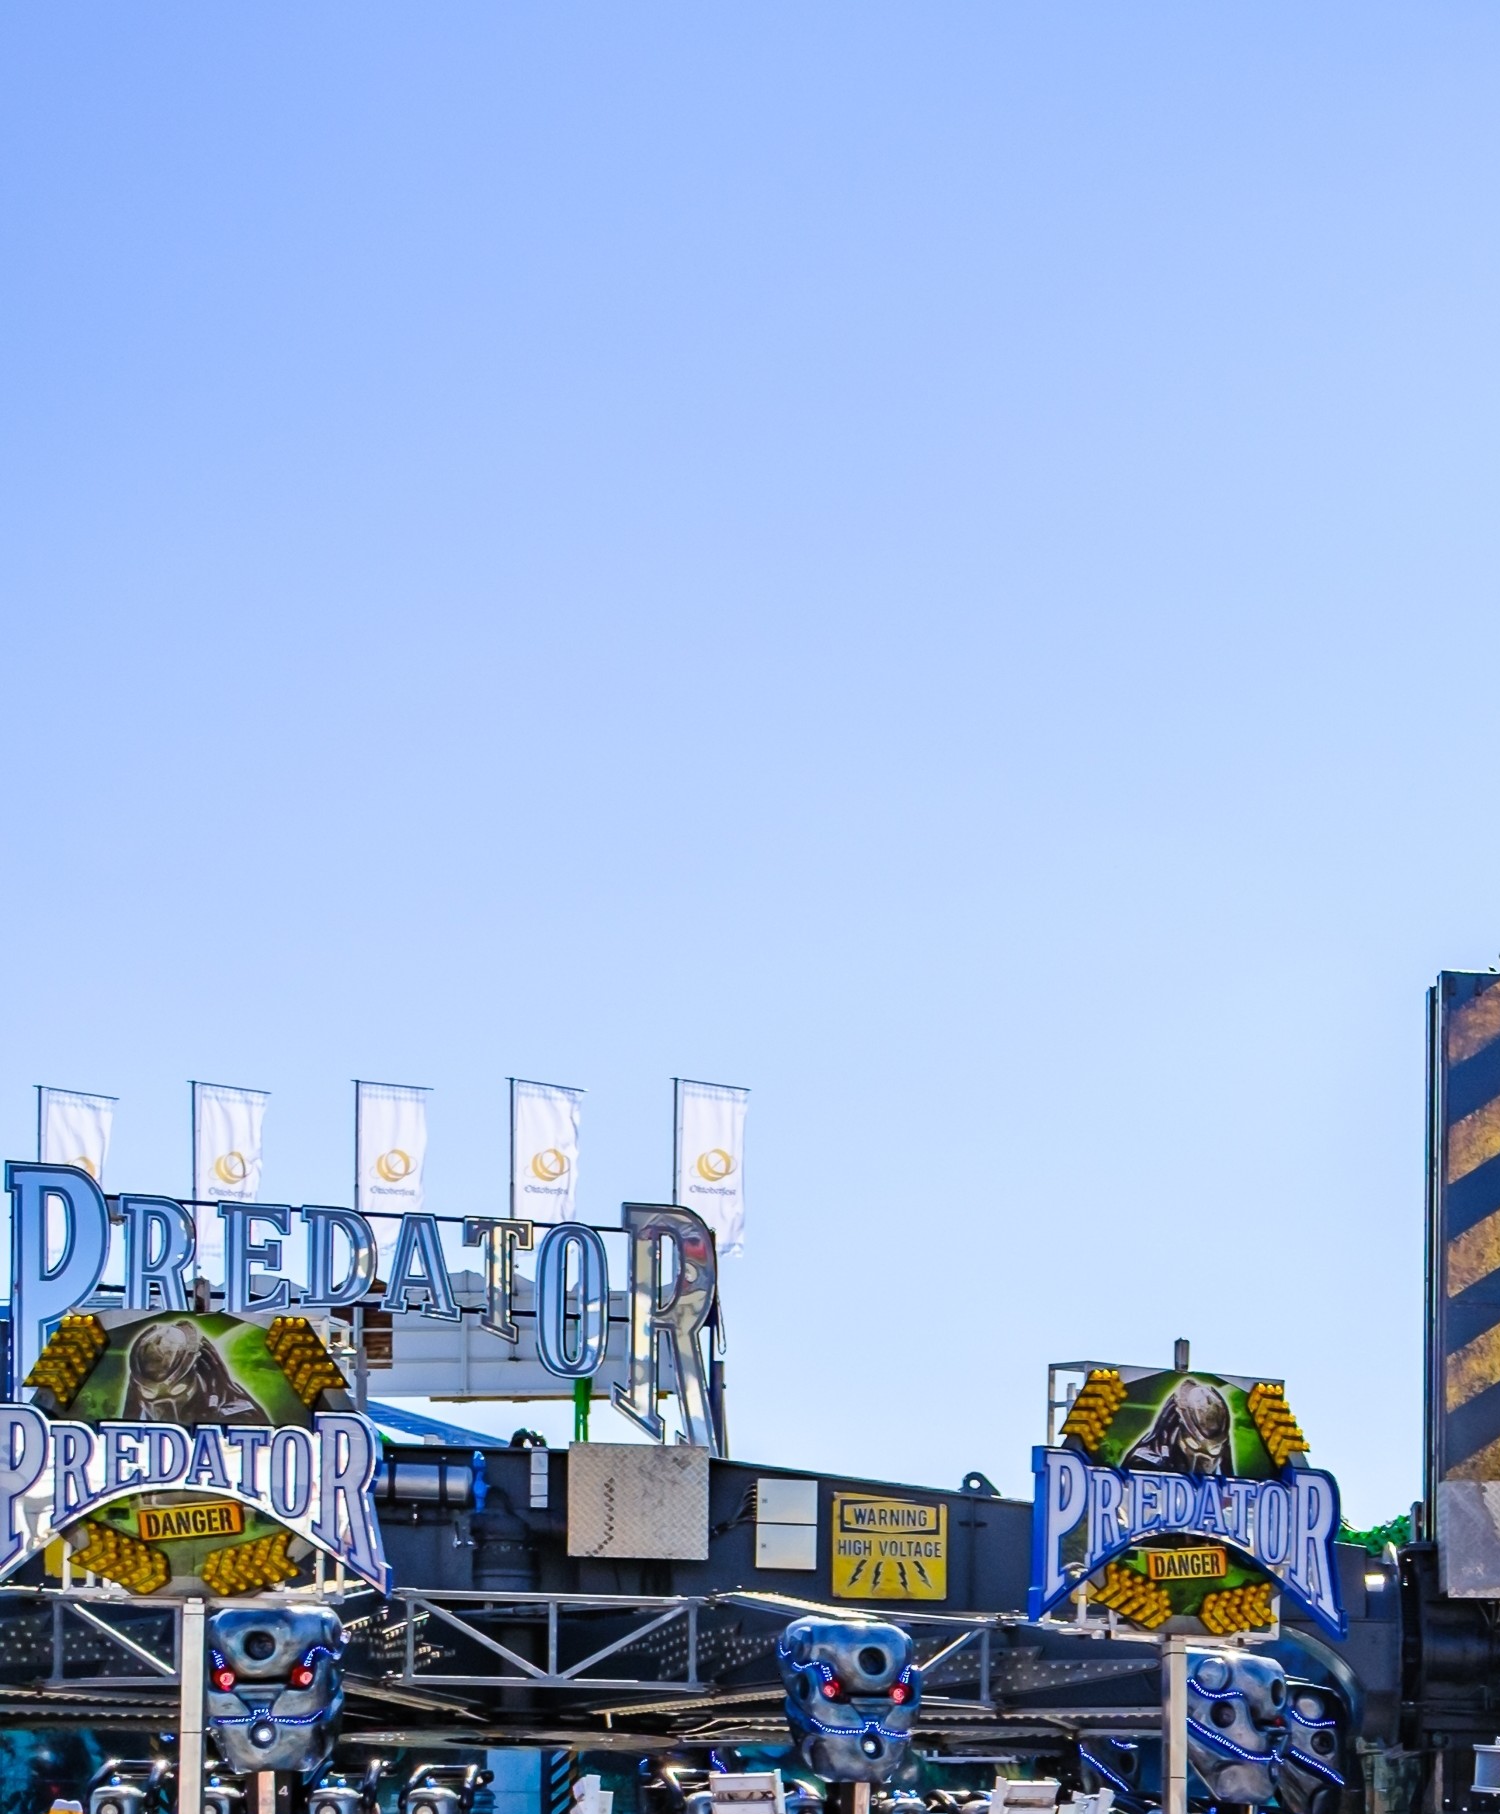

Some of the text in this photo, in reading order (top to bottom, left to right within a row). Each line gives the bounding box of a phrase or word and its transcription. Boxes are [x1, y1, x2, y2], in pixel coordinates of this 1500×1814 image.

[5, 1160, 724, 1452] PREDATOR
[0, 1405, 388, 1588] PREDATOR
[147, 1506, 234, 1538] DANGER
[853, 1503, 928, 1530] WARNING
[837, 1539, 942, 1560] HIGH VOLTAGE
[1045, 1453, 1342, 1626] PREDATOR
[1154, 1551, 1221, 1578] DANGER
[278, 1784, 289, 1797] 4
